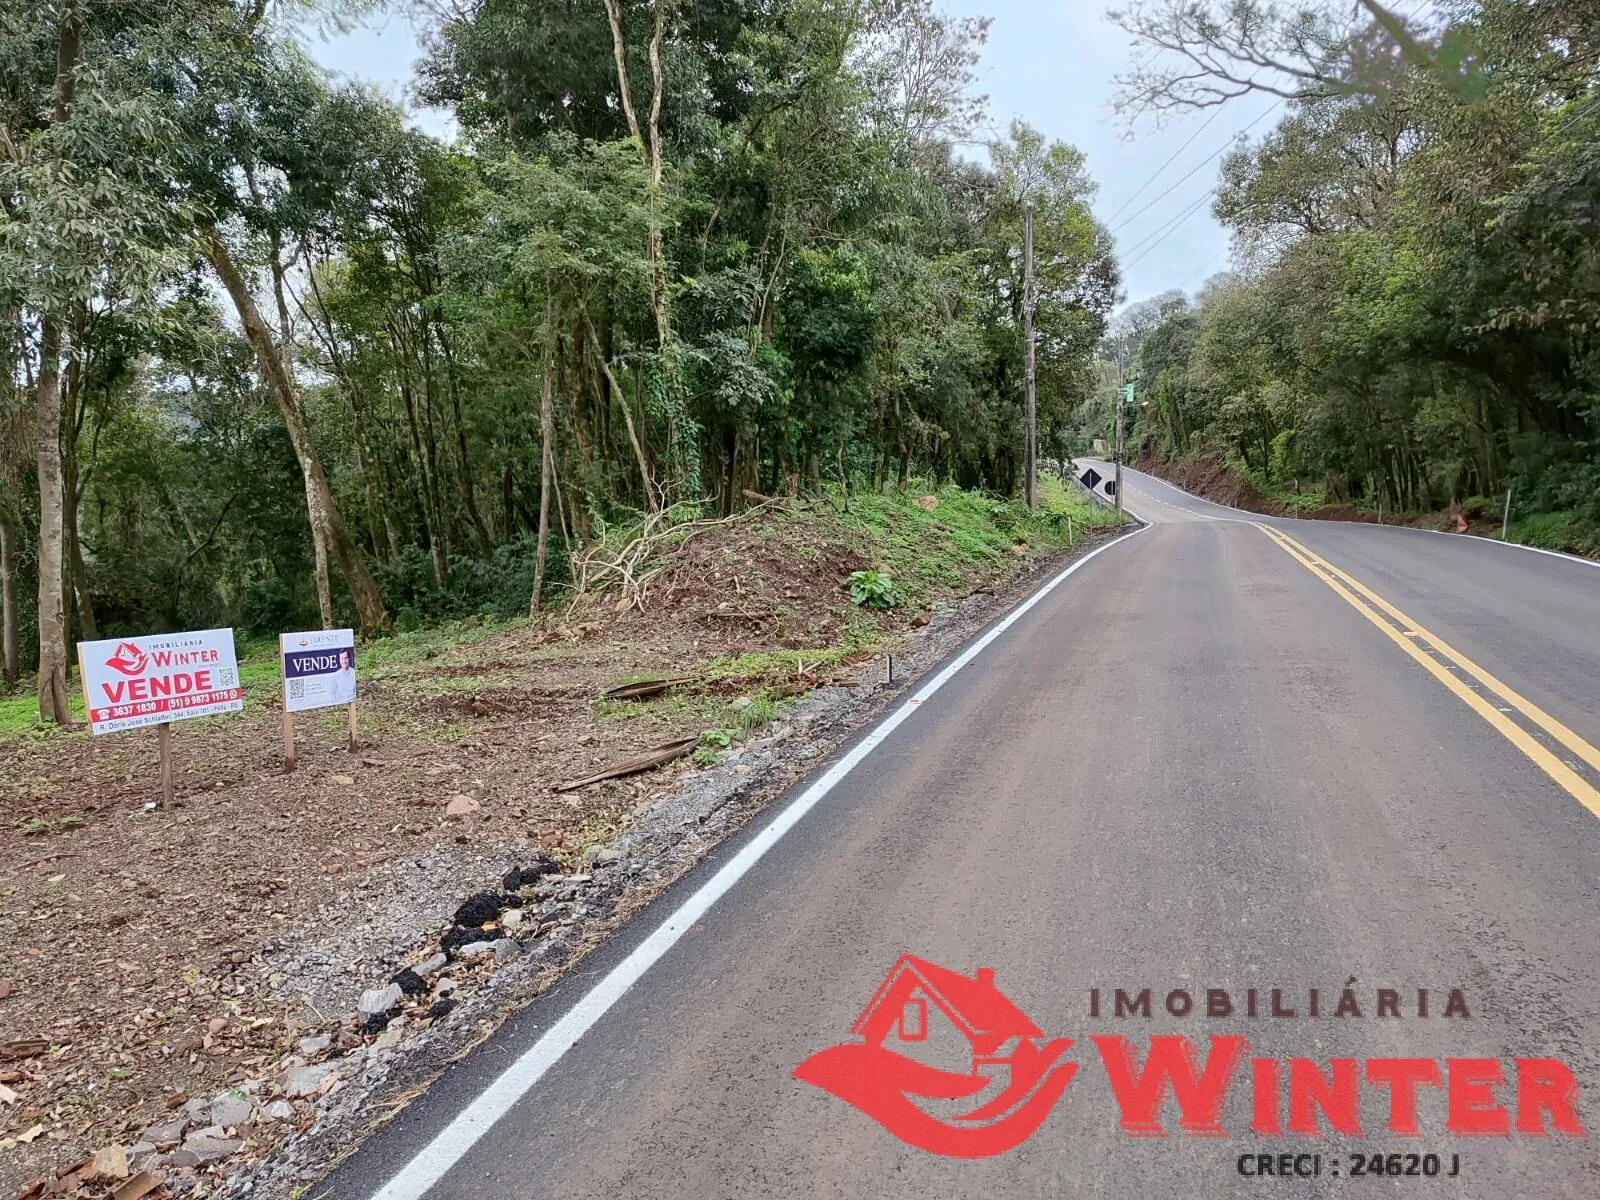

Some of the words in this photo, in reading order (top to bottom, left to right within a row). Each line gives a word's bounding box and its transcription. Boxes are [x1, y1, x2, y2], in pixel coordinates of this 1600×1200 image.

[151, 649, 218, 667] WINTER
[292, 654, 338, 672] VENDE
[101, 670, 212, 703] VENDE
[112, 705, 133, 717] 3637
[136, 702, 156, 713] 1830
[168, 698, 183, 711] (51)
[185, 696, 190, 706] 9
[191, 694, 209, 705] 9873
[211, 690, 229, 702] 1175
